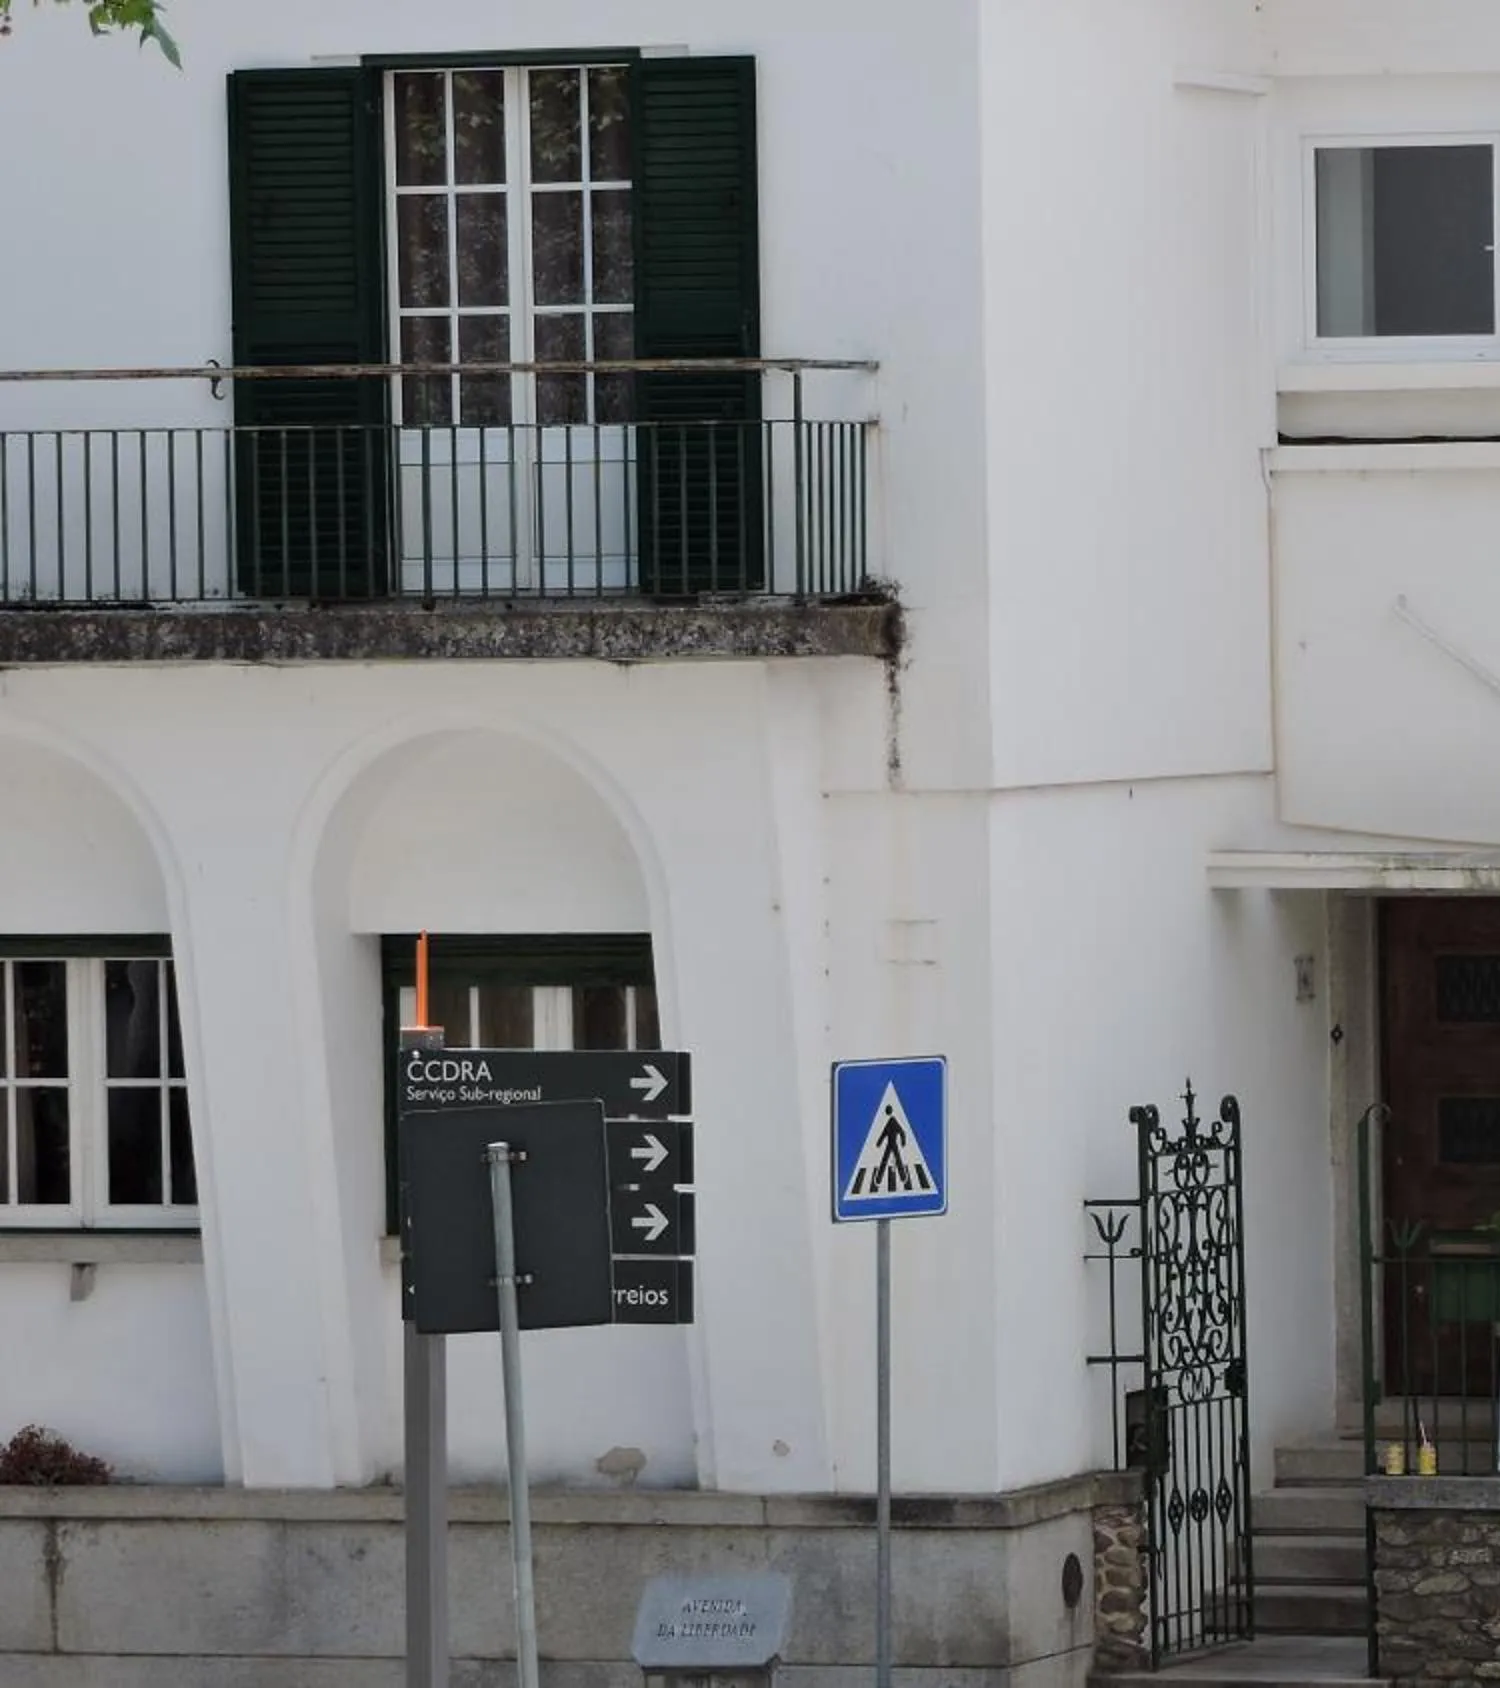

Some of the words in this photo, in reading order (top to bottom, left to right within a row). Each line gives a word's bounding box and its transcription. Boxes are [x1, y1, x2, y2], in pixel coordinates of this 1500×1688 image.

[407, 1060, 493, 1082] CCDRA
[407, 1085, 456, 1104] Serviço
[459, 1085, 541, 1105] Sub-regional
